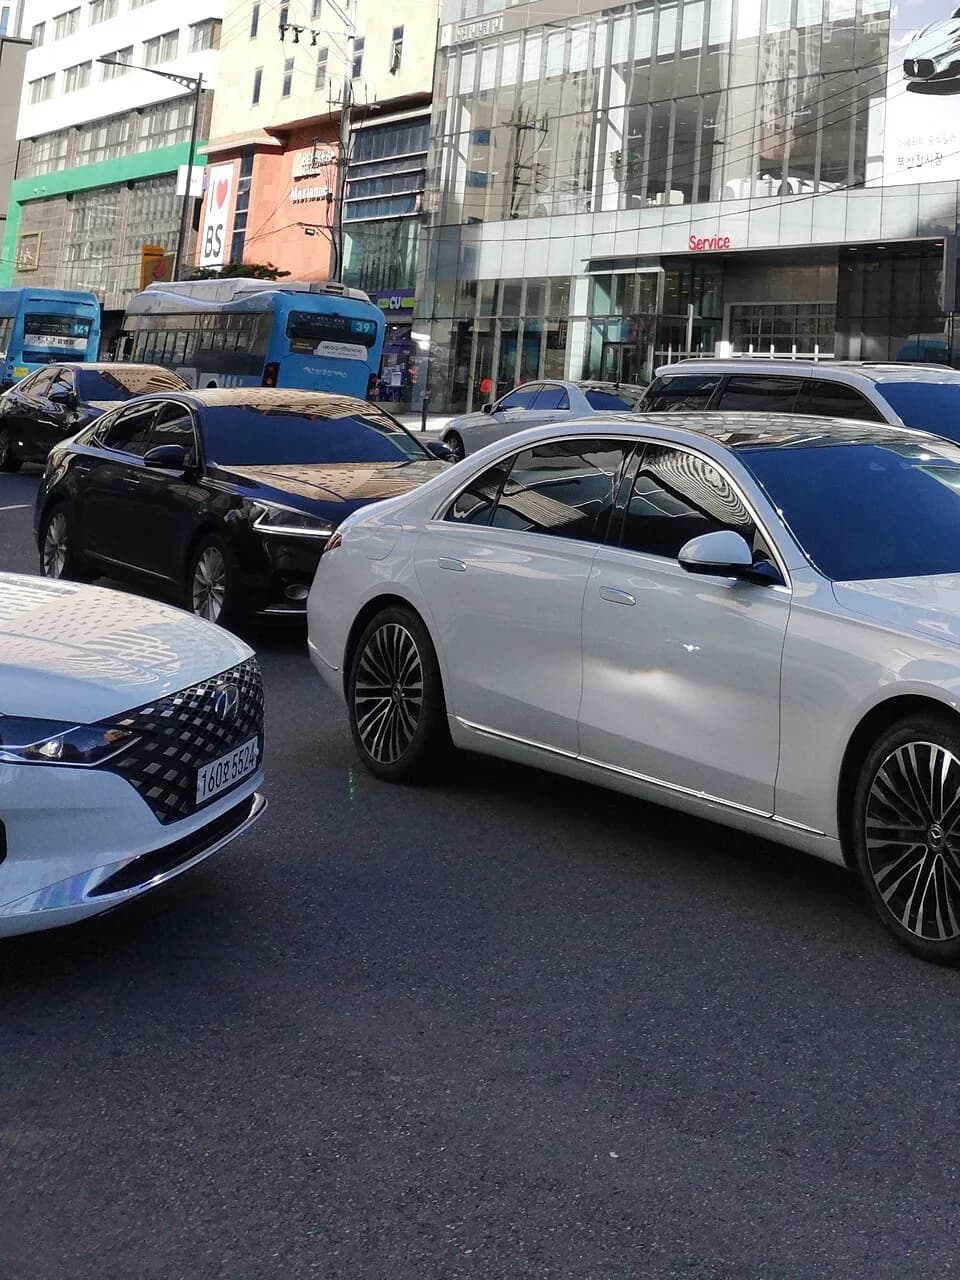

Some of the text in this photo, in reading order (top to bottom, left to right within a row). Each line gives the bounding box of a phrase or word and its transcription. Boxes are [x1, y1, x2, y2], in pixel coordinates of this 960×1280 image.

[204, 223, 223, 258] BS
[689, 233, 730, 250] Service
[389, 296, 401, 310] CU
[356, 321, 371, 333] 39
[231, 742, 256, 780] 5524
